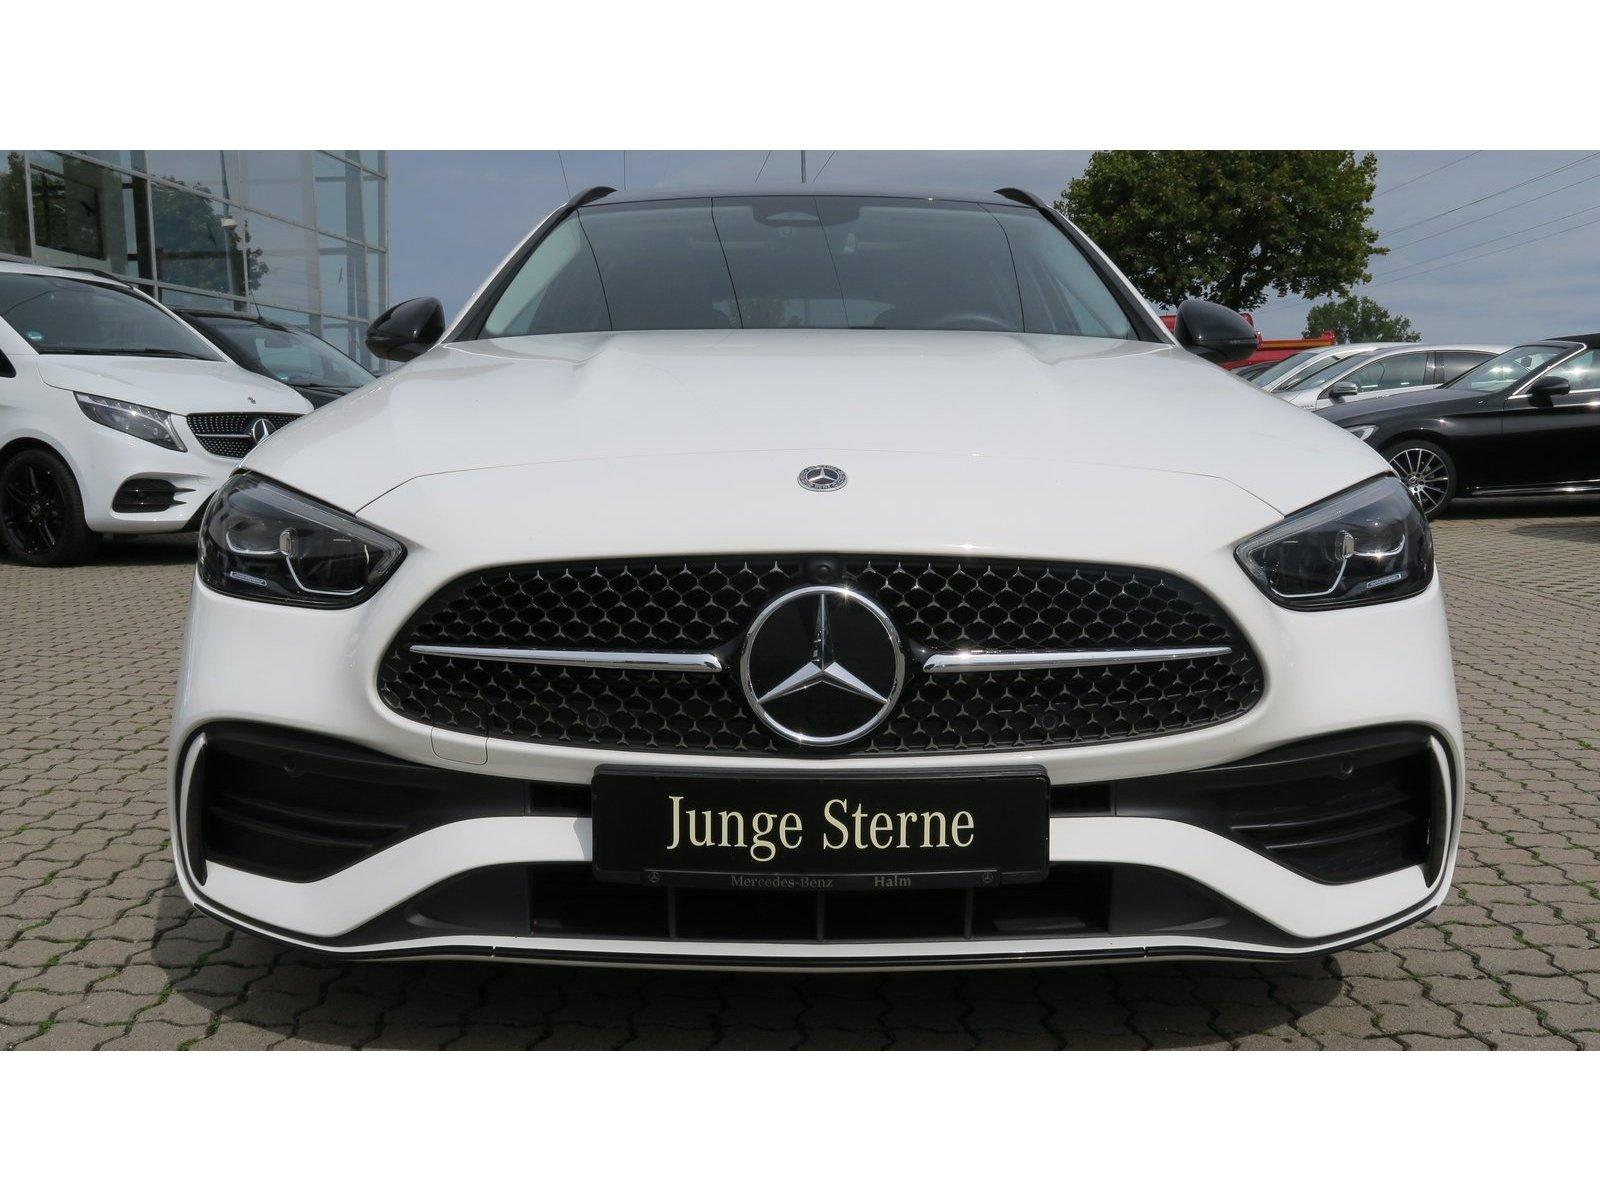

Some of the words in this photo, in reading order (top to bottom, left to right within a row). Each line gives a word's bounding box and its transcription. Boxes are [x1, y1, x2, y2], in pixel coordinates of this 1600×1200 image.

[667, 795, 803, 862] Junge
[823, 798, 975, 850] Sterne
[731, 874, 833, 888] Mercedes-Benz
[874, 874, 912, 887] Halm
